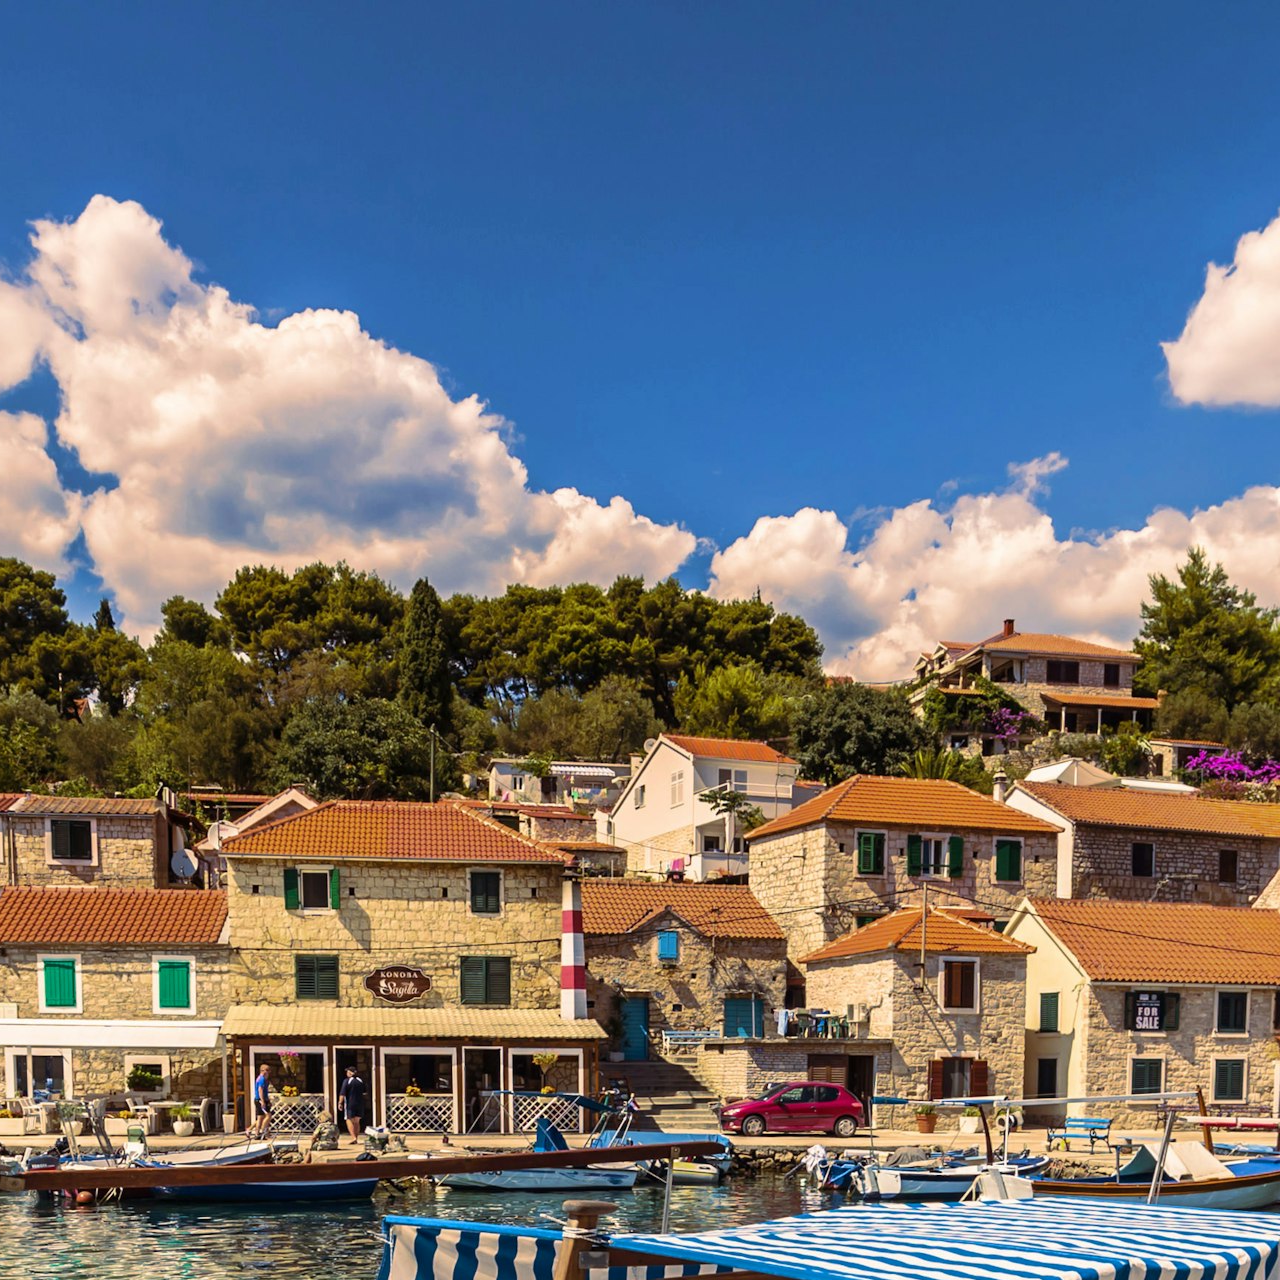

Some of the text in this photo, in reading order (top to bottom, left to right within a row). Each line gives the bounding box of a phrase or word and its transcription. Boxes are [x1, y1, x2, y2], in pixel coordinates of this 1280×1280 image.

[380, 971, 418, 979] KONOBA
[1138, 1006, 1158, 1016] FOR
[1135, 1016, 1160, 1029] SALE
